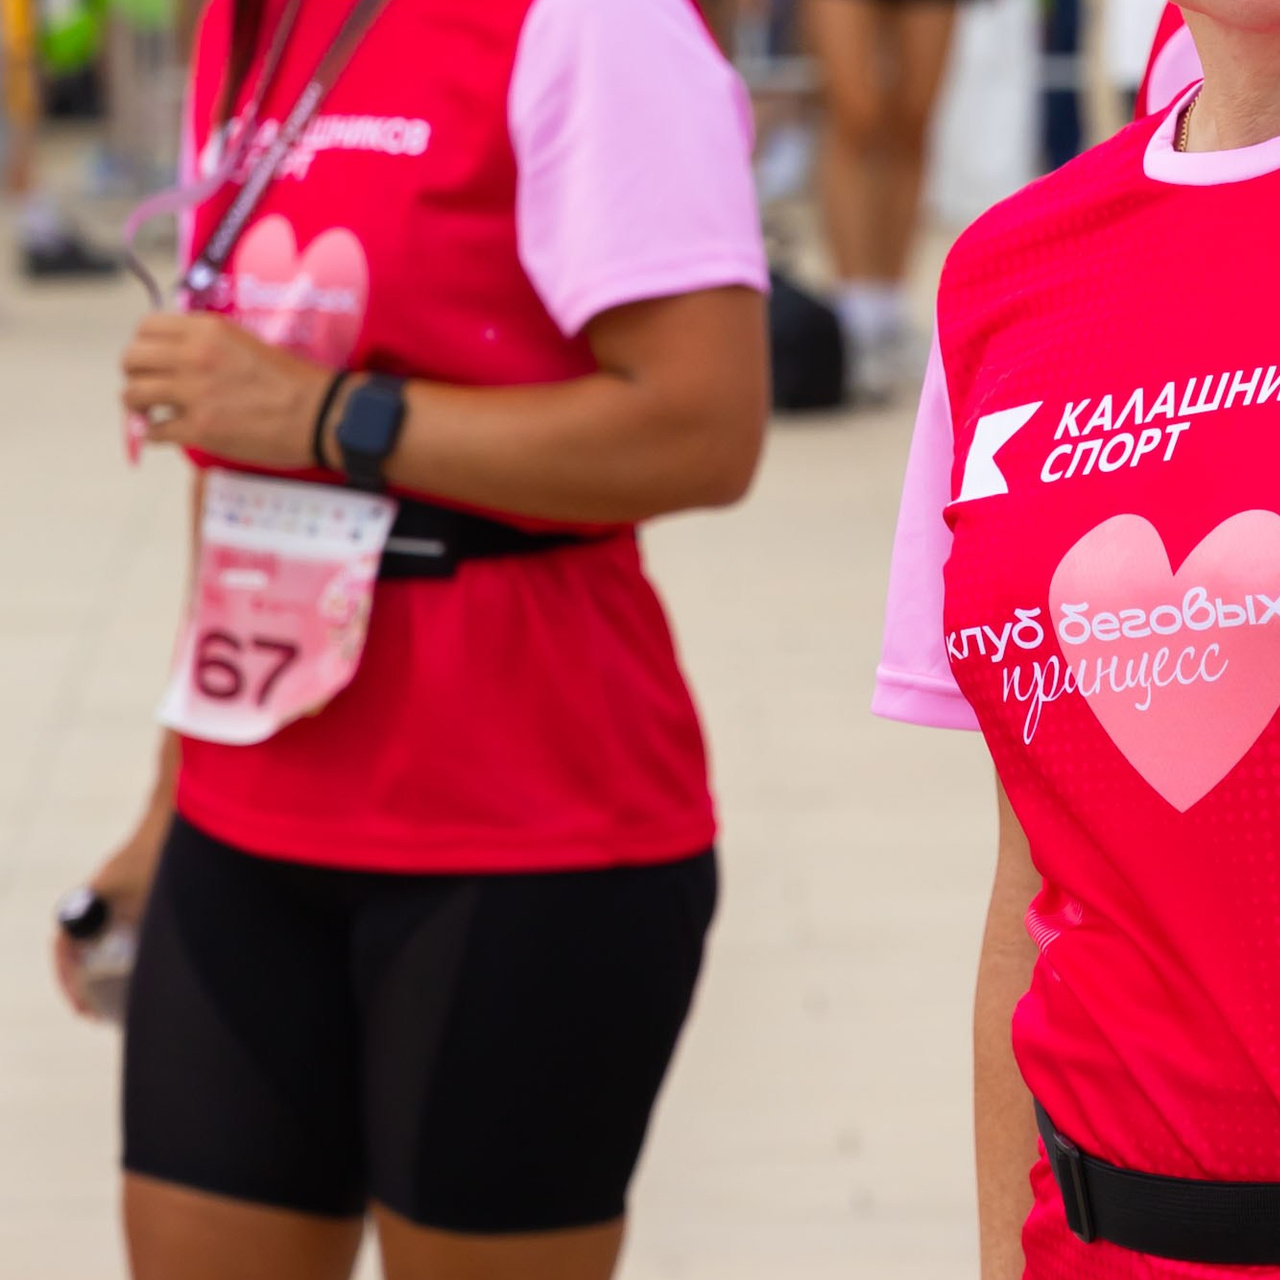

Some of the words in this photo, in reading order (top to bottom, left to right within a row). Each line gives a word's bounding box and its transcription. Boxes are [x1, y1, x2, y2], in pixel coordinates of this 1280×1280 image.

[1040, 421, 1191, 483] СПОРТ
[946, 607, 1044, 663] клуб
[1002, 642, 1229, 745] принцесс
